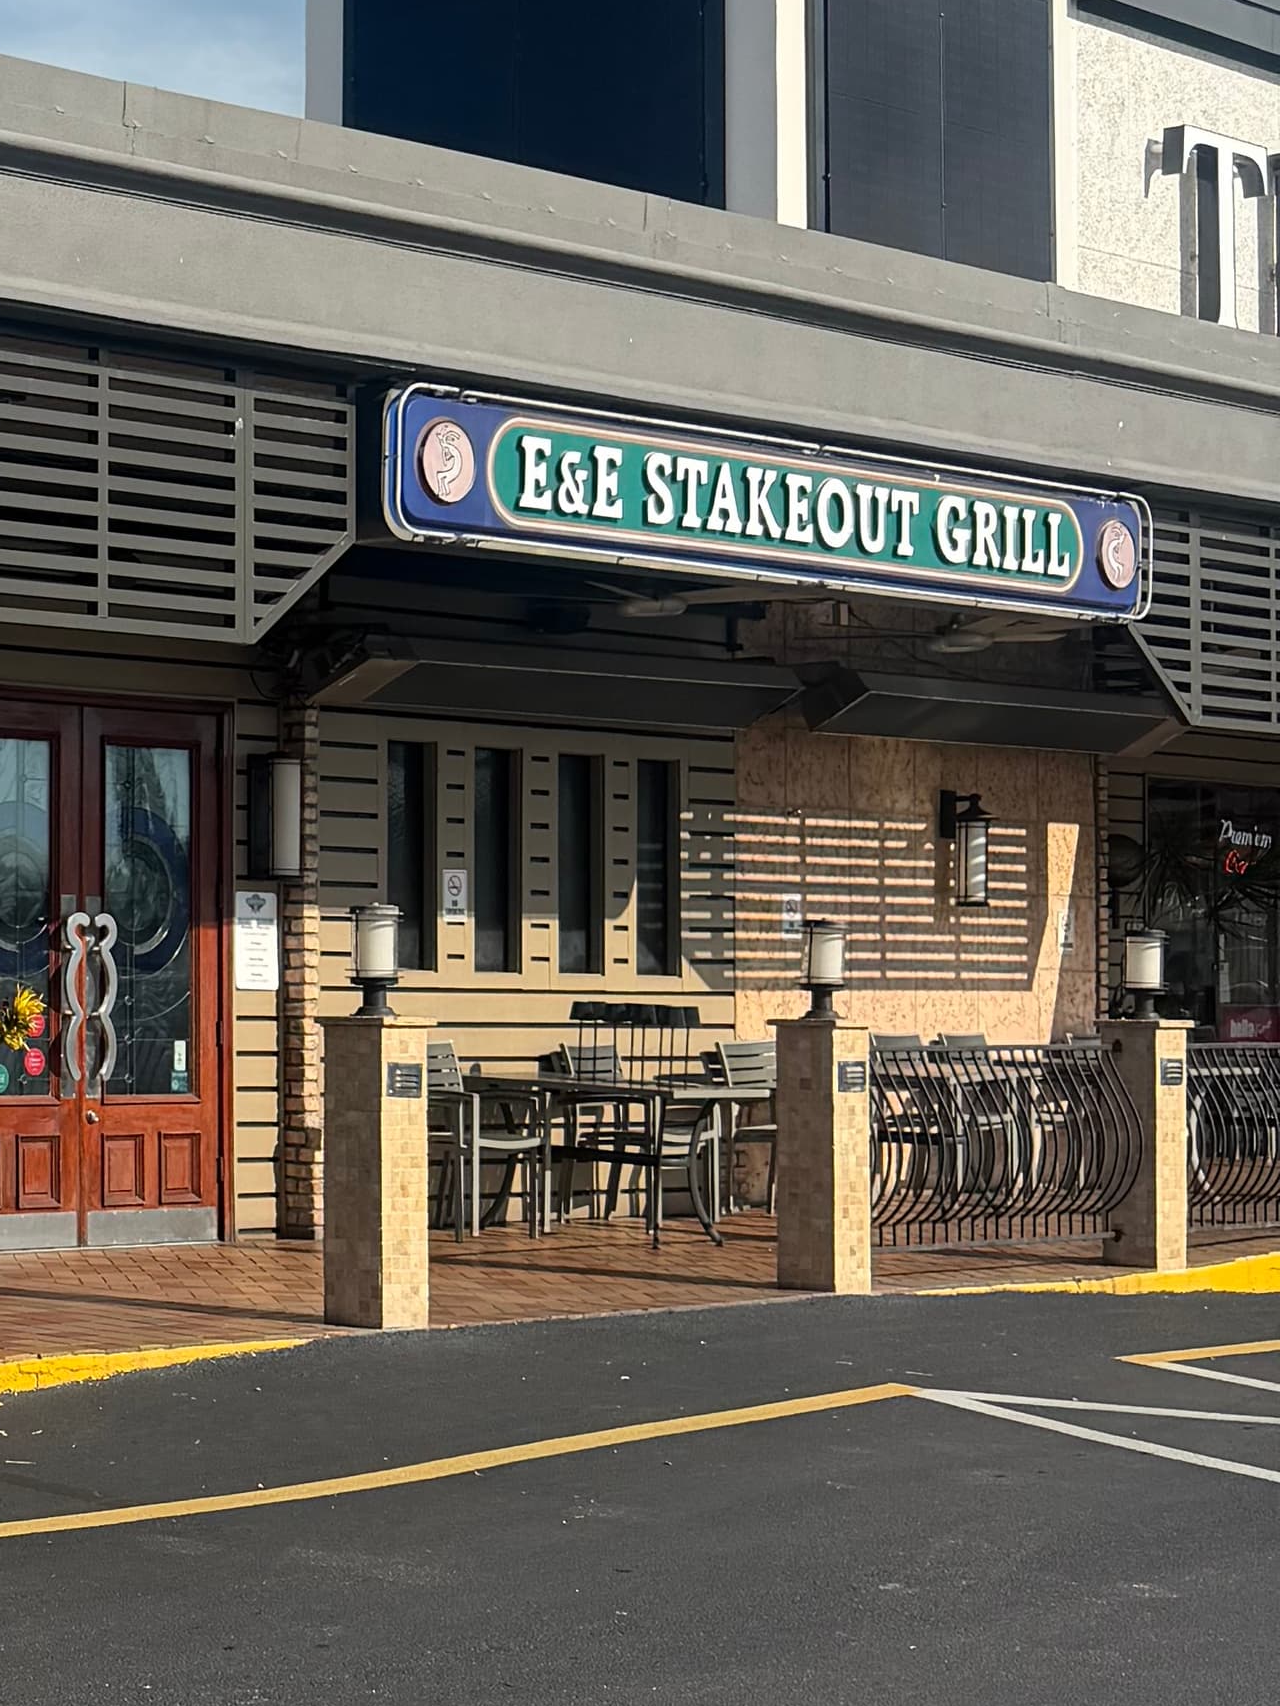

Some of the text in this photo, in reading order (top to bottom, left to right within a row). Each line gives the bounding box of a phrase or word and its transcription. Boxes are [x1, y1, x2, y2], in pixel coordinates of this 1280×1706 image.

[518, 434, 1072, 578] E&E STAKEOUT GRILL
